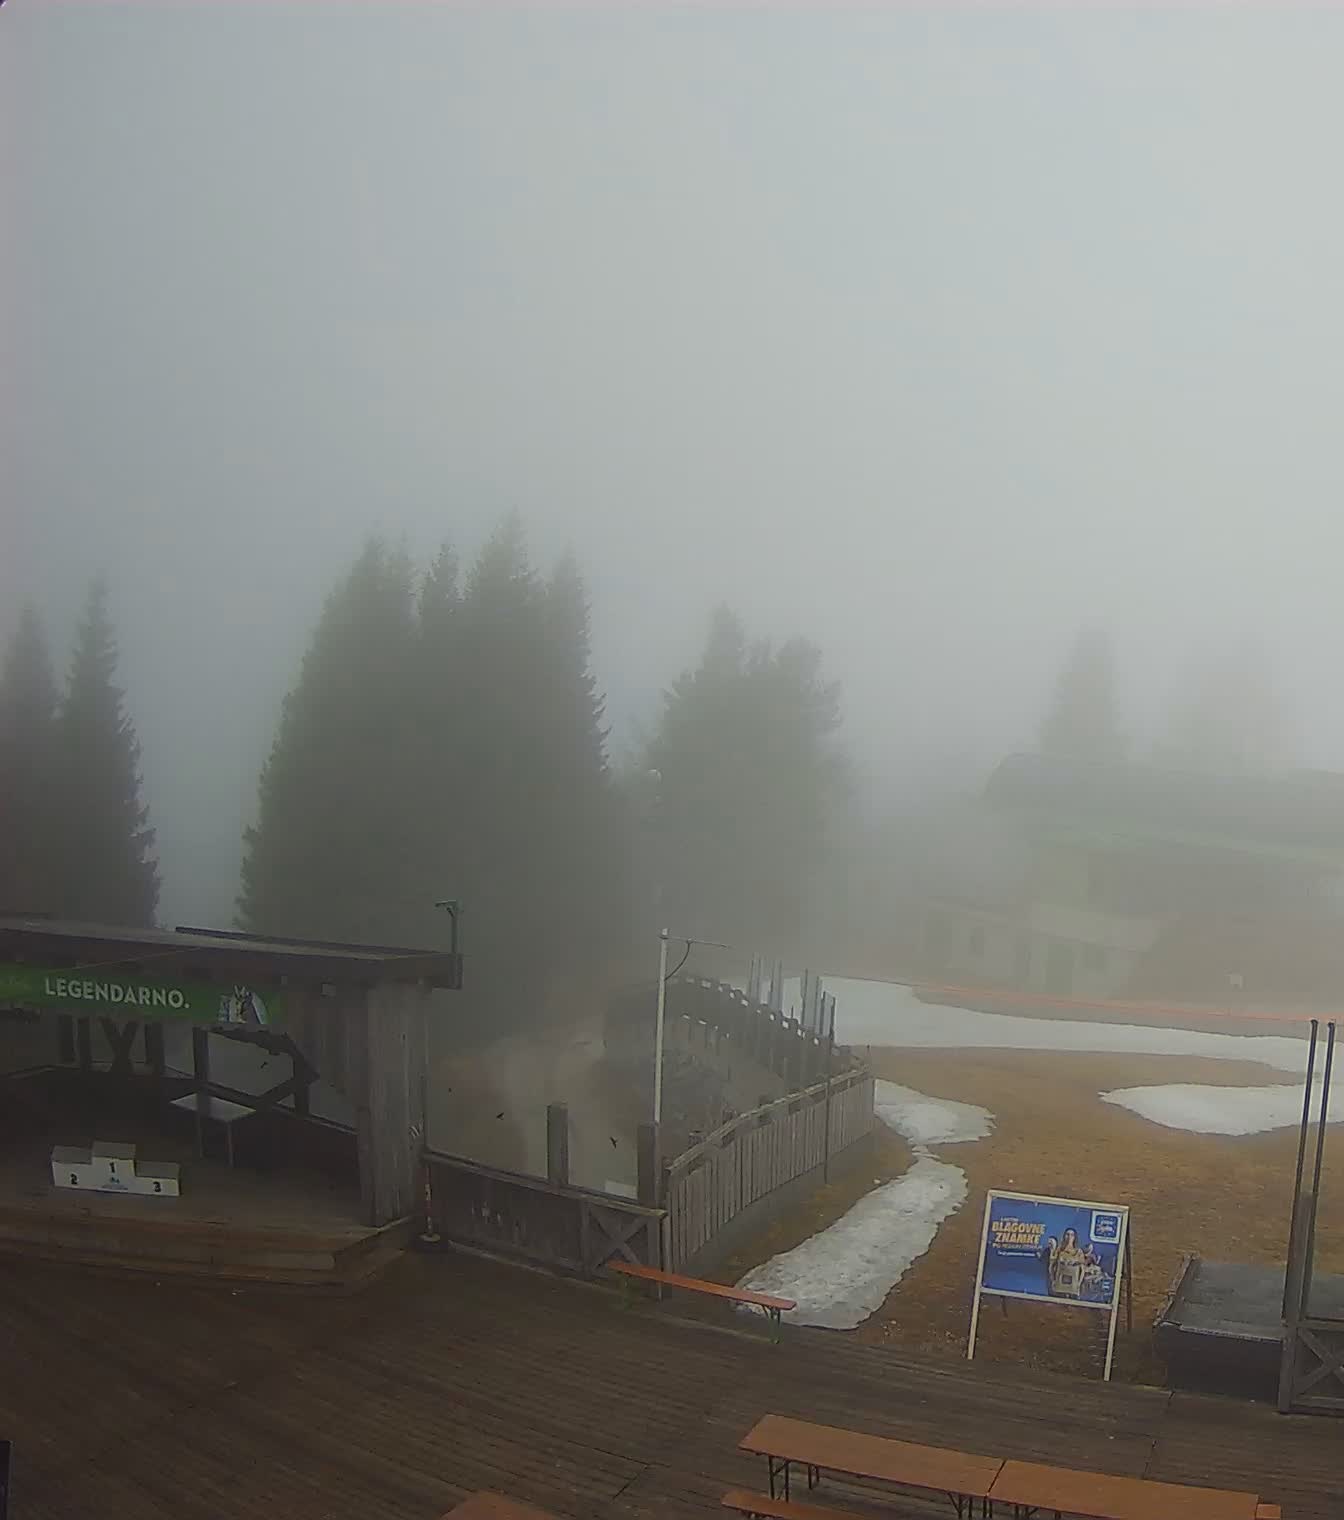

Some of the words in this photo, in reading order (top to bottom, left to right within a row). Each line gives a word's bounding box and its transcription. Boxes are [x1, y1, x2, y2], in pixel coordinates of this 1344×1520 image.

[44, 977, 190, 1009] LEGENDARNO.
[109, 1161, 116, 1174] 1
[70, 1173, 79, 1185] 2
[153, 1181, 162, 1193] 3
[991, 1221, 1046, 1234] BLAGOVNE
[994, 1232, 1041, 1244] ZNAMKE
